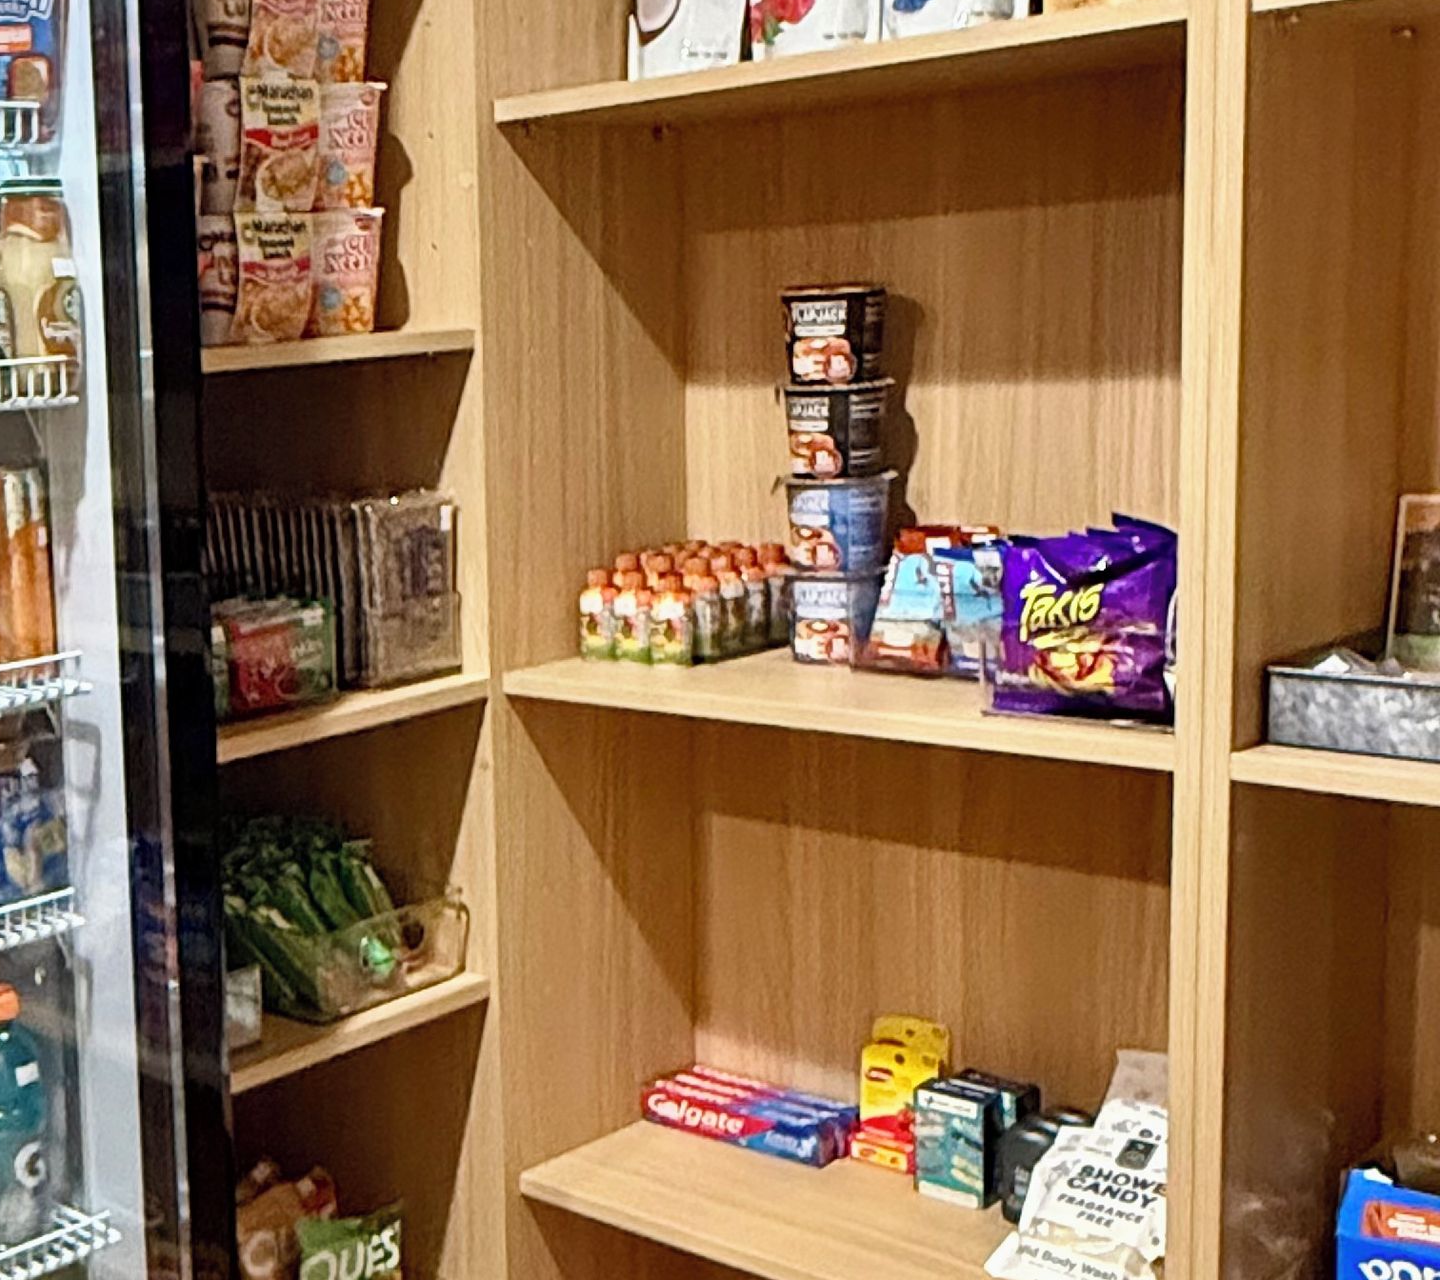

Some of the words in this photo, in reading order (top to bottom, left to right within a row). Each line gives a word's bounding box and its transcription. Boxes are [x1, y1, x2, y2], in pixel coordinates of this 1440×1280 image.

[1019, 581, 1105, 643] Takis
[647, 1093, 745, 1134] Colgate
[15, 1141, 47, 1189] G
[1057, 1192, 1145, 1225] FRAGRANCE
[1067, 1176, 1158, 1209] CANDY
[1076, 1210, 1114, 1229] FREE
[1042, 1250, 1077, 1272] Body
